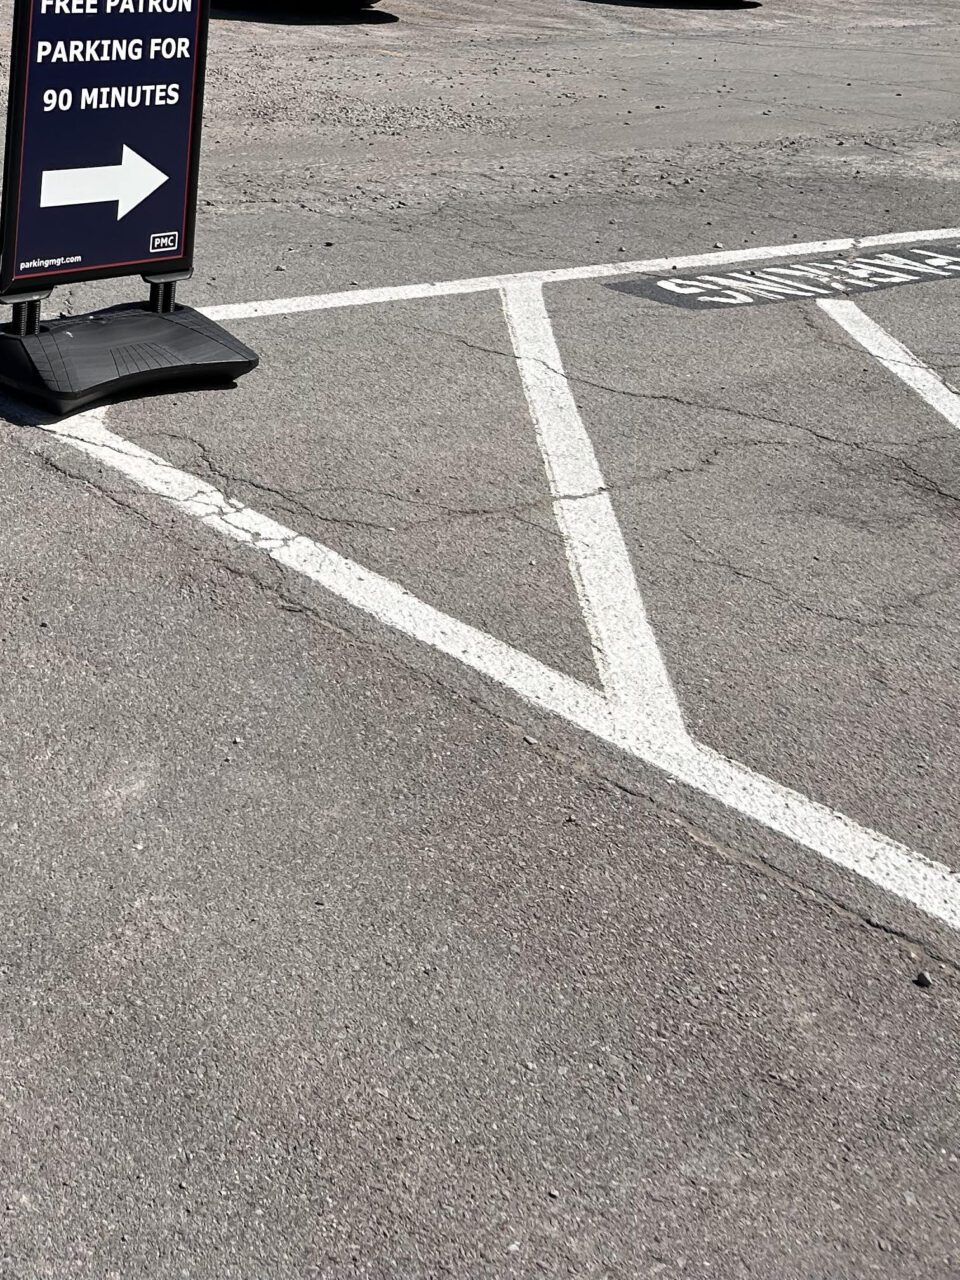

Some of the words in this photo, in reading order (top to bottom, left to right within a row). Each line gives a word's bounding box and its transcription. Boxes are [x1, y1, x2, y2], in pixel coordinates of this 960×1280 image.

[36, 38, 143, 63] PARKING
[149, 37, 190, 59] FOR
[43, 88, 72, 112] 90
[80, 83, 180, 110] MINUTES
[154, 235, 175, 248] PMC
[20, 254, 82, 271] parkingmgt.com
